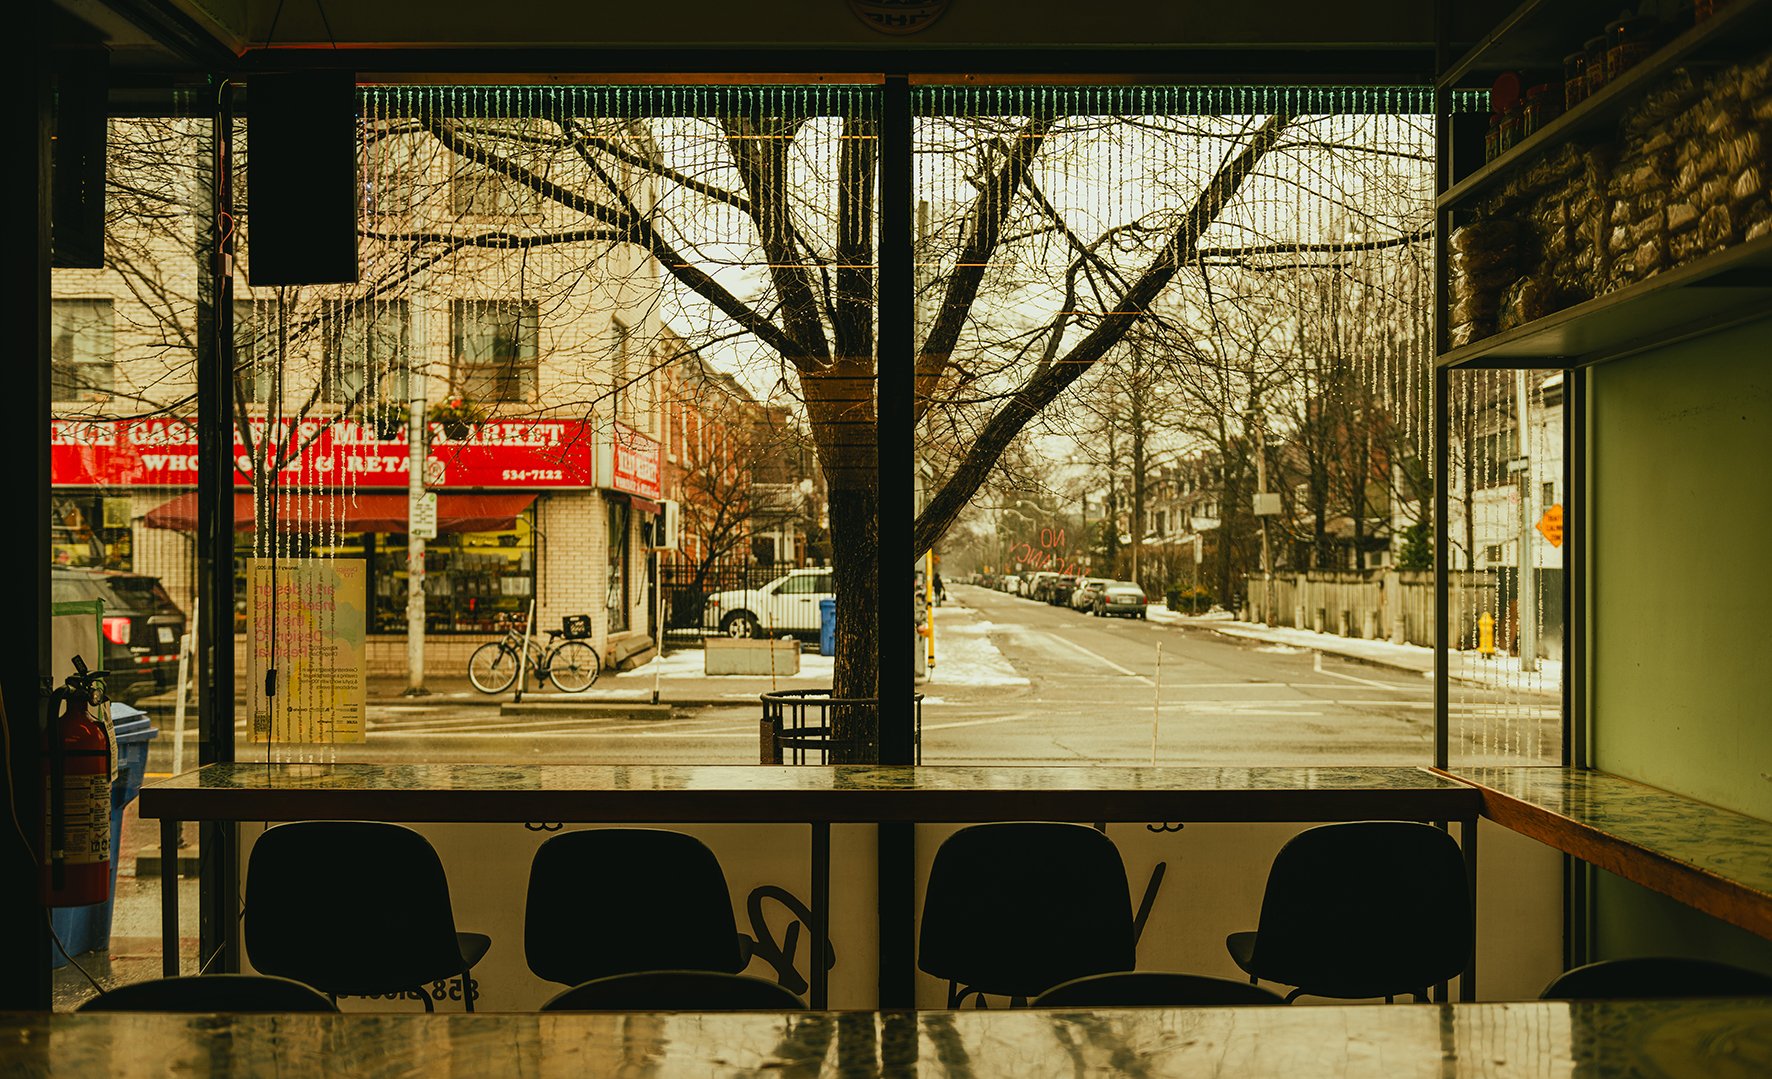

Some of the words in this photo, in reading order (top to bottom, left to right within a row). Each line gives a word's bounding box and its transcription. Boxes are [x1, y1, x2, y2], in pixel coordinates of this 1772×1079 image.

[51, 422, 116, 446] NCE
[315, 456, 335, 473] &
[502, 469, 563, 481] 534-7122
